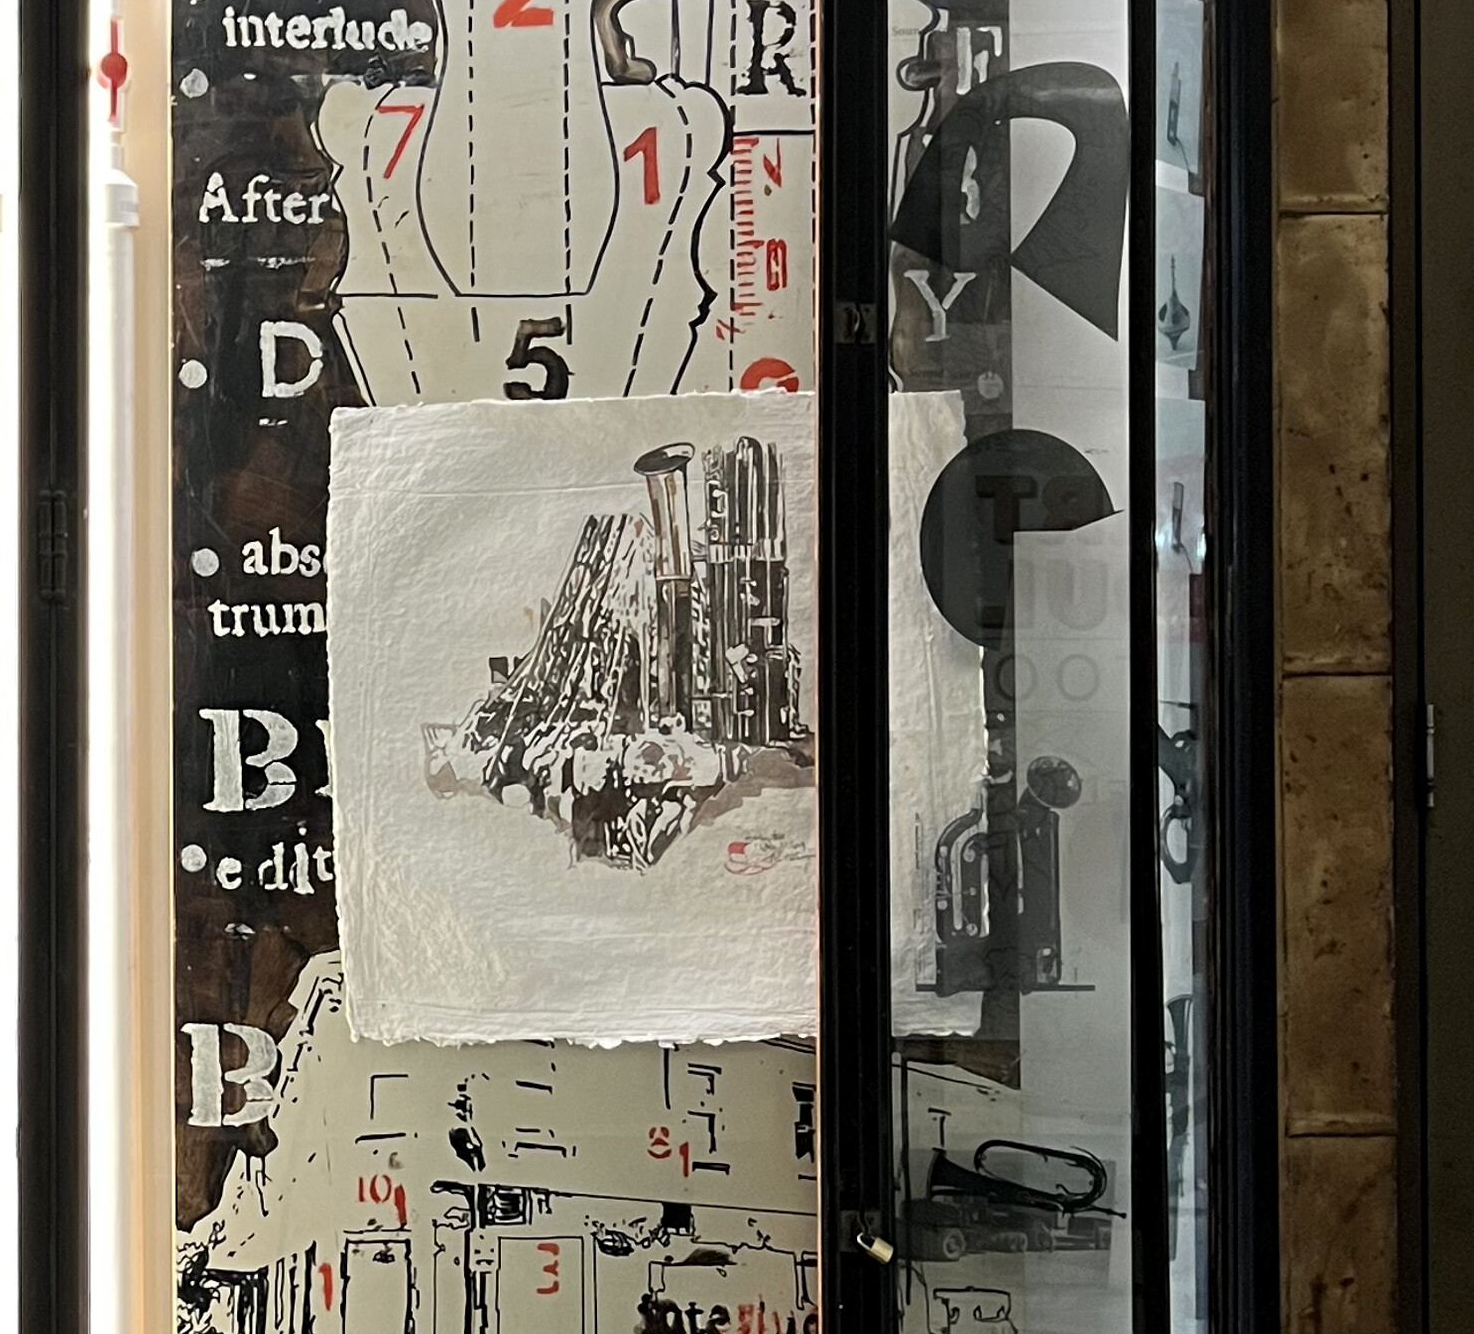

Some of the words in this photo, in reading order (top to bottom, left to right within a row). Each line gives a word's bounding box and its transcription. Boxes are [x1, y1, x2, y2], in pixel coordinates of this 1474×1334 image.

[222, 5, 433, 52] interlude
[376, 103, 425, 180] 7
[623, 126, 661, 206] 1
[198, 172, 330, 225] After
[903, 268, 977, 343] Y
[259, 320, 324, 398] D
[502, 316, 570, 401] 5
[242, 526, 328, 577] abs
[179, 1022, 279, 1128] B
